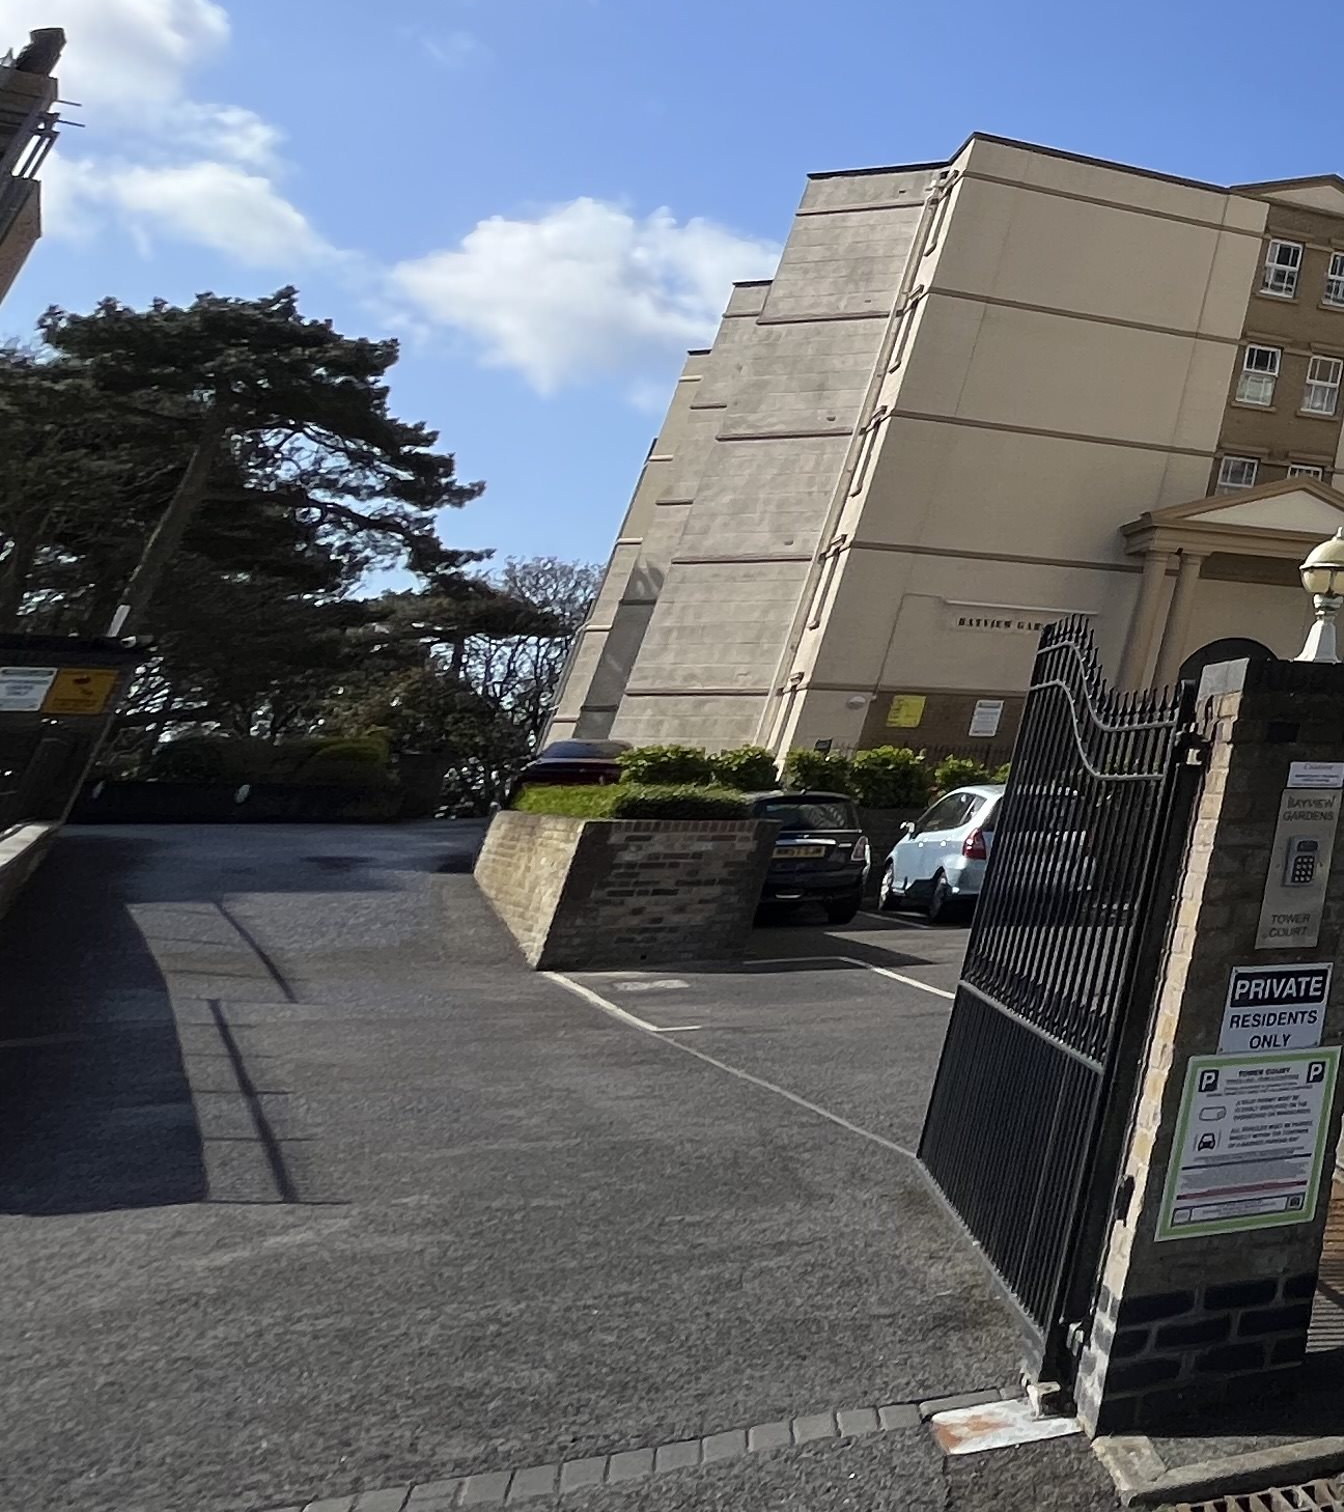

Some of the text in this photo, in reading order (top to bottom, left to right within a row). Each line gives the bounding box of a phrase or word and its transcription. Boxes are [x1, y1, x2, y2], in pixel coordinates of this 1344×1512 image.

[1282, 810, 1335, 822] GARDENS
[1271, 913, 1311, 925] TOWER
[1268, 926, 1308, 938] COURT
[1234, 976, 1323, 1000] PRIVATE
[1229, 1010, 1318, 1028] RESIDENTS
[1249, 1033, 1291, 1049] ONLY
